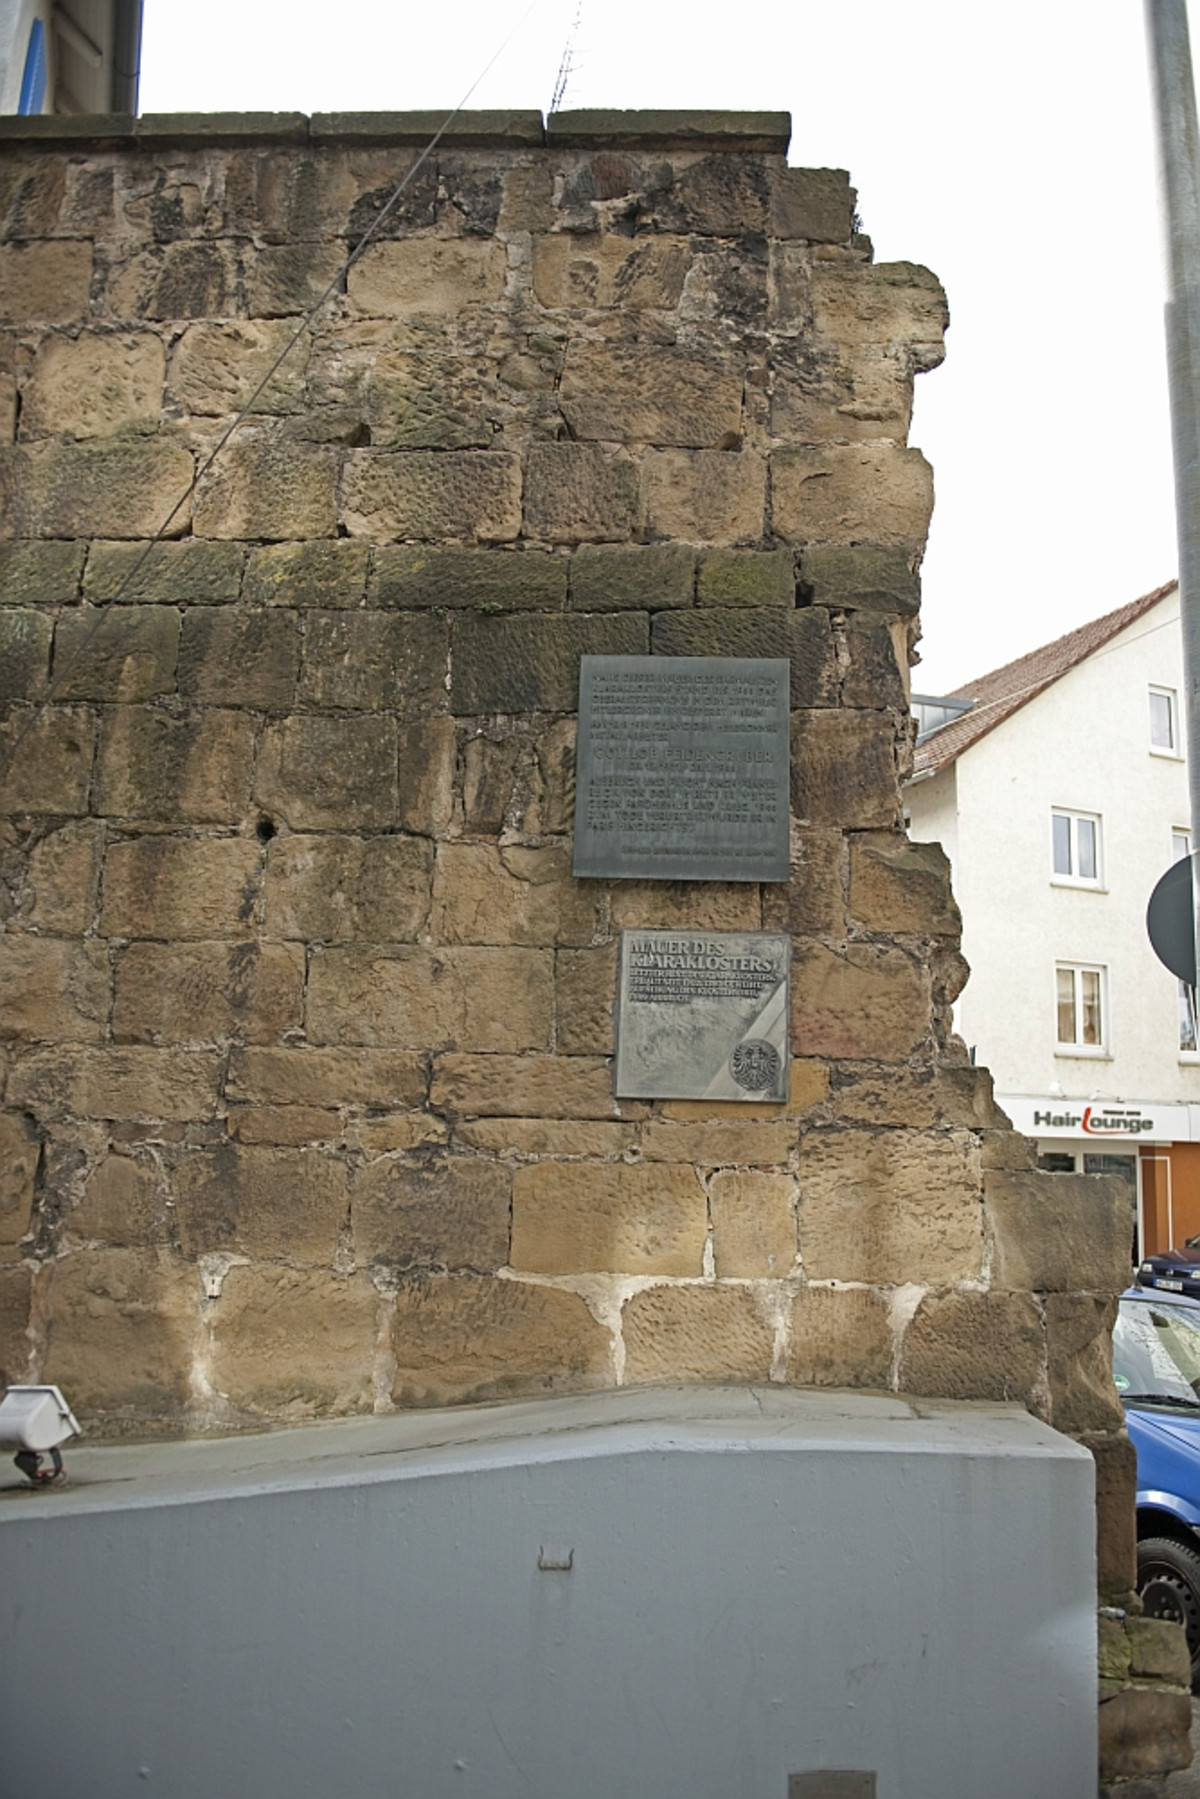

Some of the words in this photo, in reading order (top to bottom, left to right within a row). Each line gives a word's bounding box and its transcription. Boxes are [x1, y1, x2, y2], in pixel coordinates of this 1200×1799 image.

[630, 940, 689, 953] MAUER
[693, 941, 725, 956] DES
[630, 954, 773, 973] KLARAKLOSTERS
